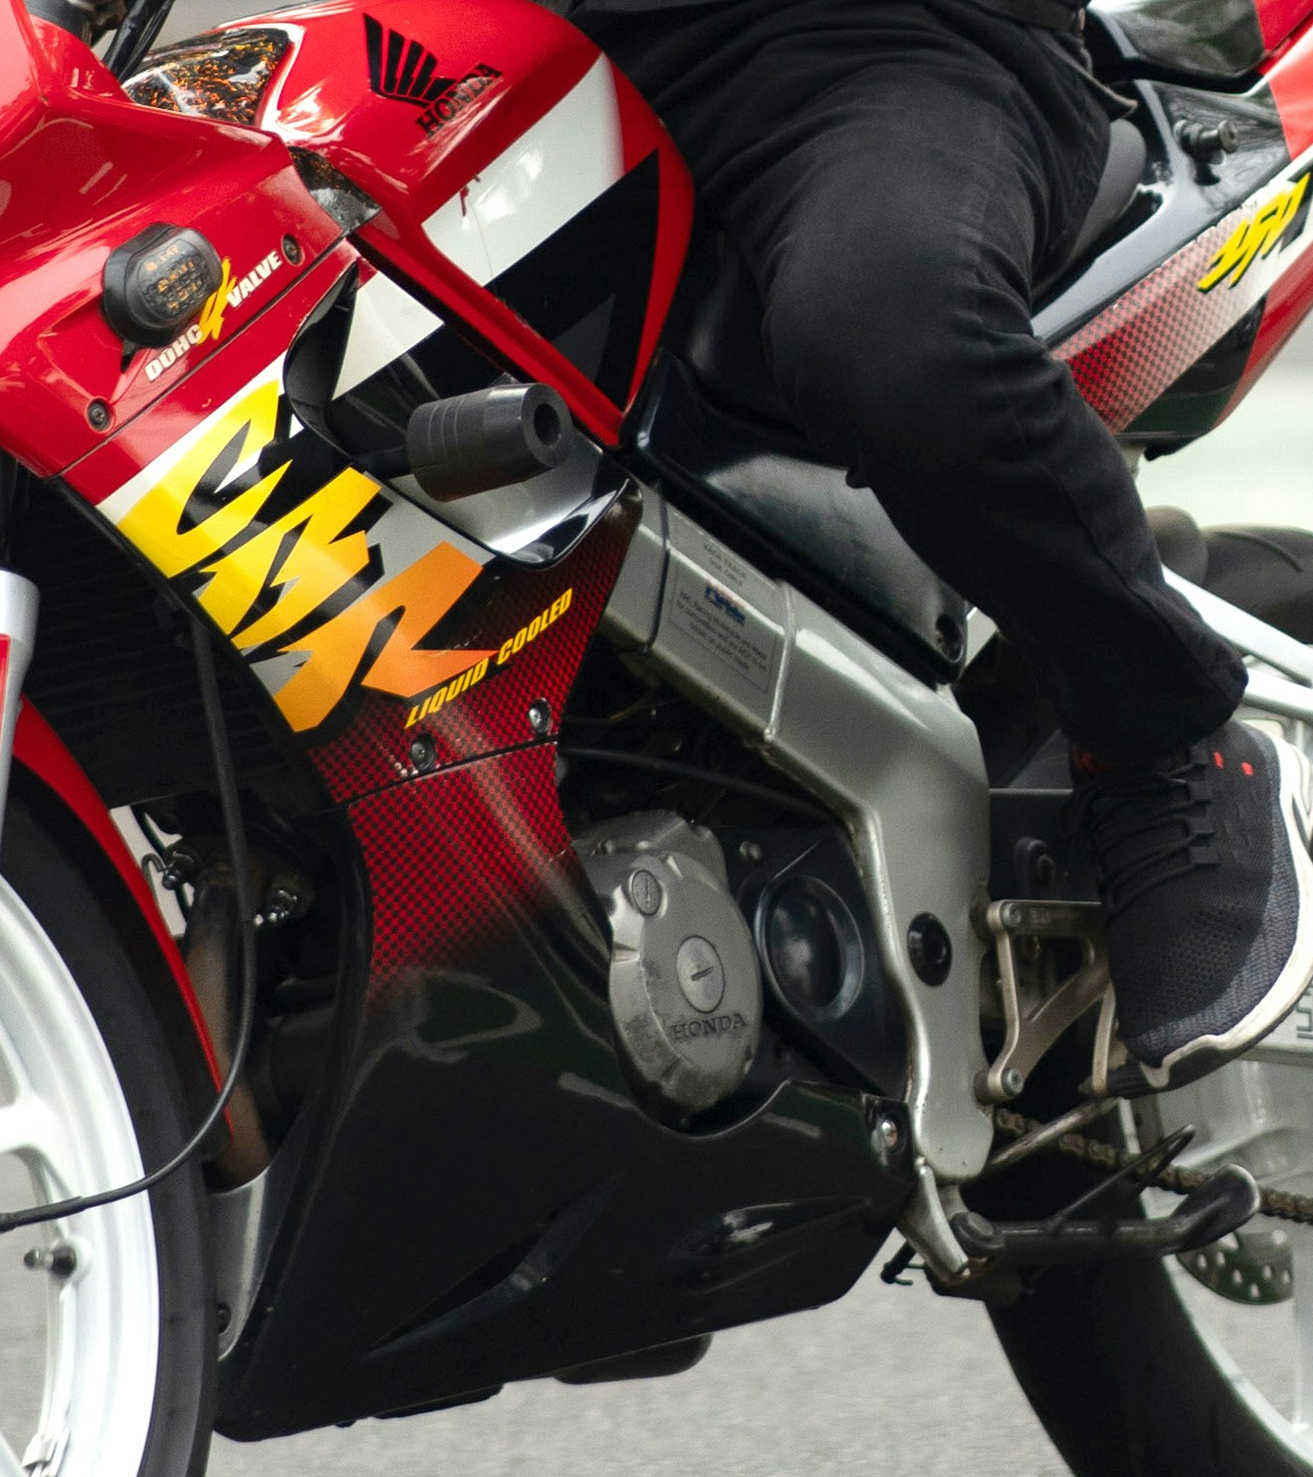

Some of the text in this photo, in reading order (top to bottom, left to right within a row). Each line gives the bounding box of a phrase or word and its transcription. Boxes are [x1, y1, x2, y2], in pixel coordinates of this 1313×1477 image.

[415, 62, 503, 138] HONDA
[144, 323, 204, 382] DOHC
[225, 249, 283, 309] VALVE
[404, 587, 573, 730] LIQUID COOLED
[669, 1012, 749, 1042] HONDA
